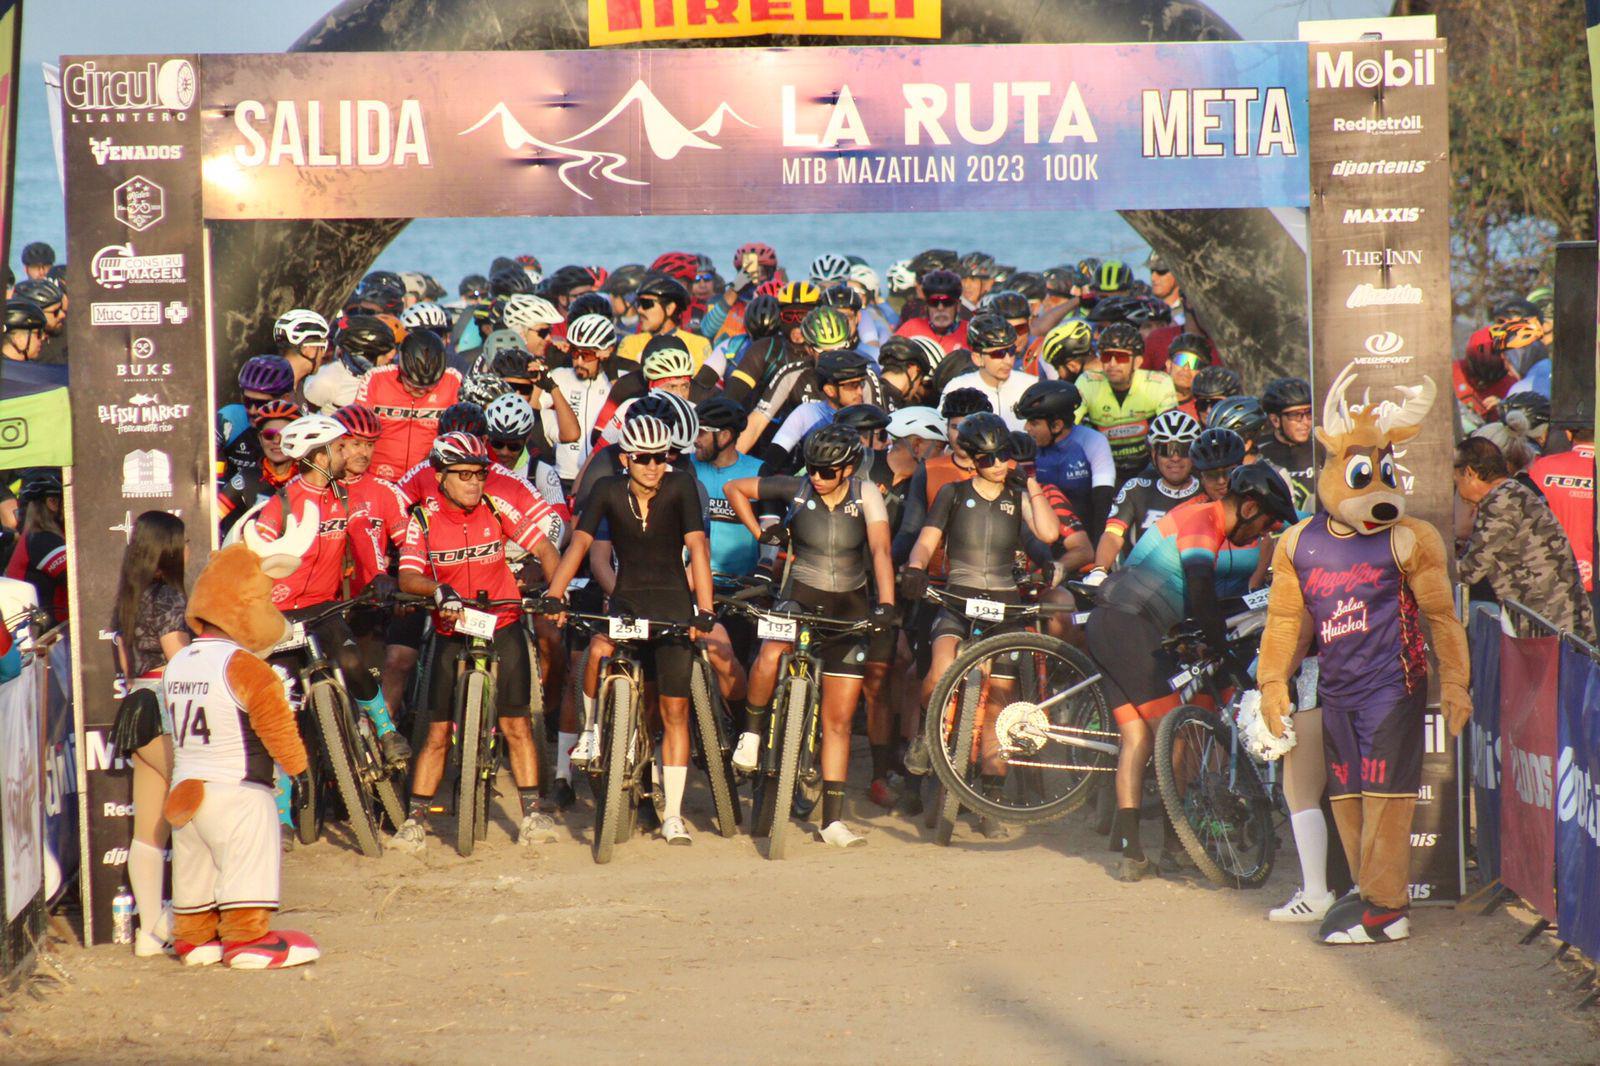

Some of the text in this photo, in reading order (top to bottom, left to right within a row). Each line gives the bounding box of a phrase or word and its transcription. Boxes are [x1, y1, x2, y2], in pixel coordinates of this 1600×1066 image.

[1315, 48, 1437, 89] Mobil
[71, 112, 186, 124] LLANTERO
[781, 80, 1099, 147] LA RUTA
[1141, 86, 1297, 158] META
[233, 99, 432, 168] SALIDA
[89, 136, 184, 166] VENADOS
[782, 152, 1099, 185] MTB MAZATLAN 2023 100K
[1343, 207, 1420, 224] MAXXIS
[1342, 248, 1423, 266] THE INN
[96, 305, 155, 321] Muc-Off
[116, 363, 172, 376] BUKS
[141, 404, 190, 423] MARKET
[1331, 597, 1366, 620] Salsa
[766, 621, 793, 634] 192
[1320, 608, 1368, 644] Huichol
